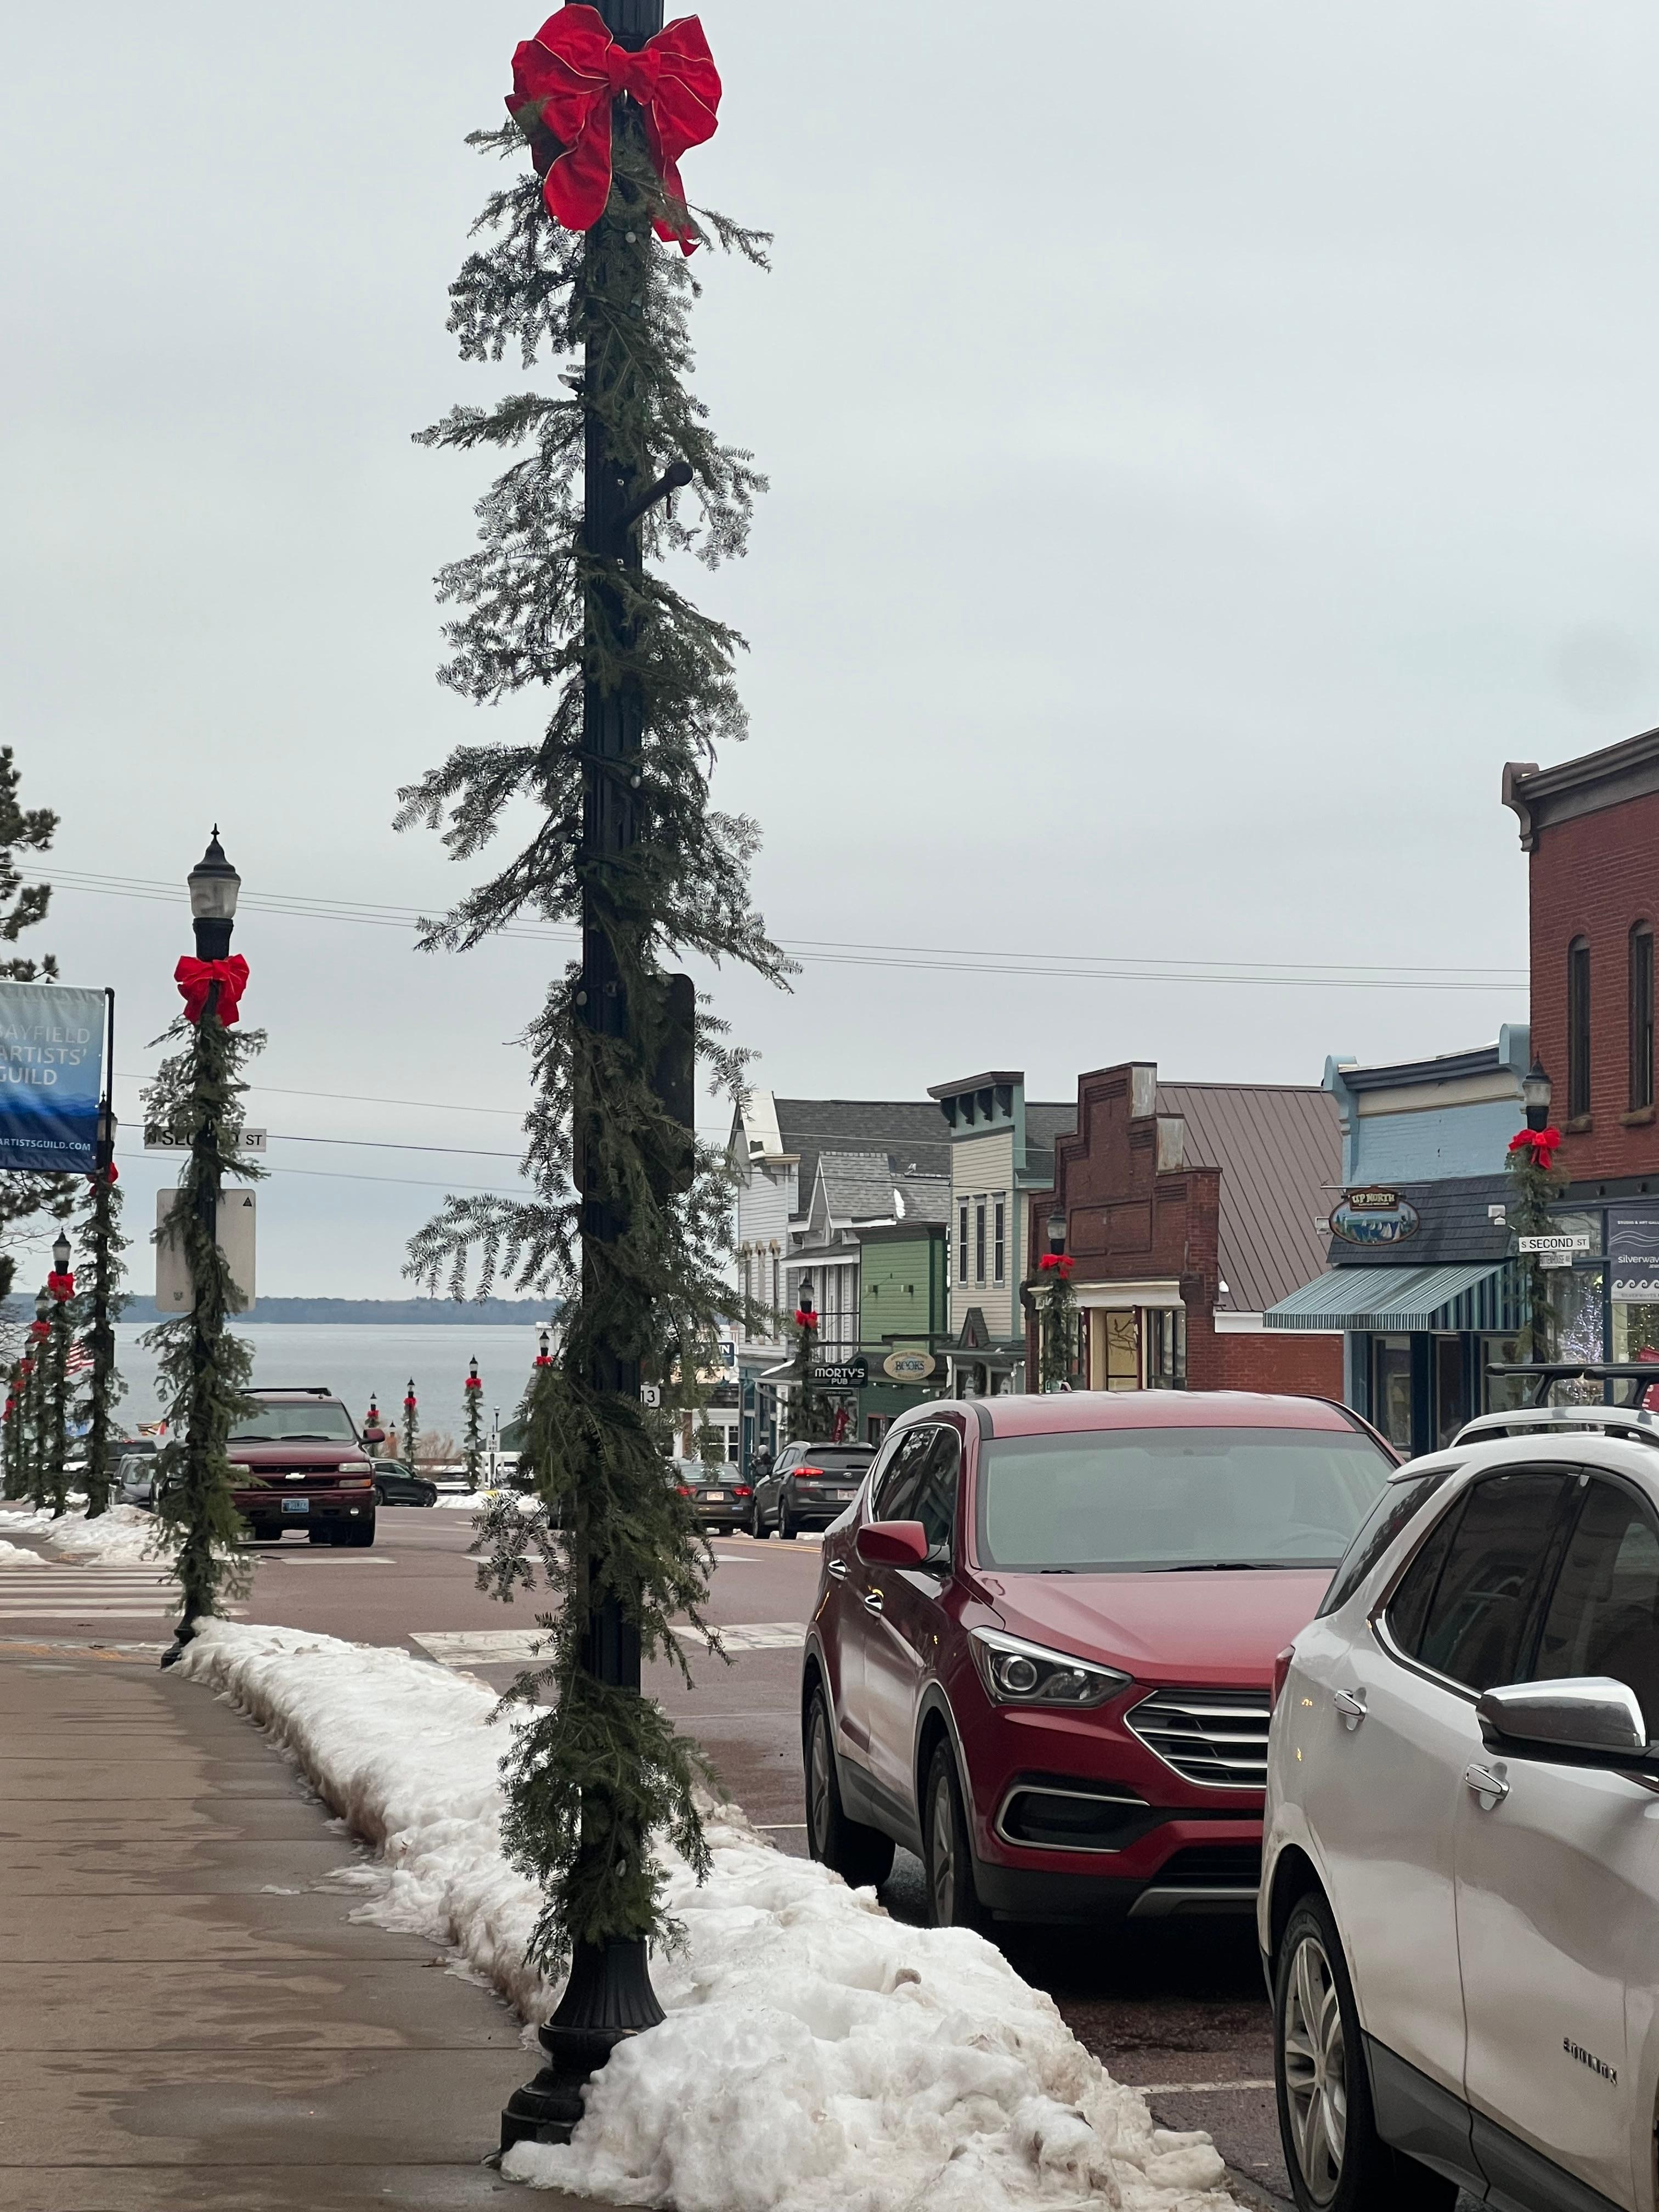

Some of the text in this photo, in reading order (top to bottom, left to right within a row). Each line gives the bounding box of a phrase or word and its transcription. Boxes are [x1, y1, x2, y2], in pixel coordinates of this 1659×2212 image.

[246, 1134, 263, 1146] ST
[1352, 1193, 1395, 1204] UP NORTH
[1529, 1238, 1573, 1249] SECOND
[895, 1360, 924, 1371] BOOKS
[815, 1368, 865, 1378] MORTY'S
